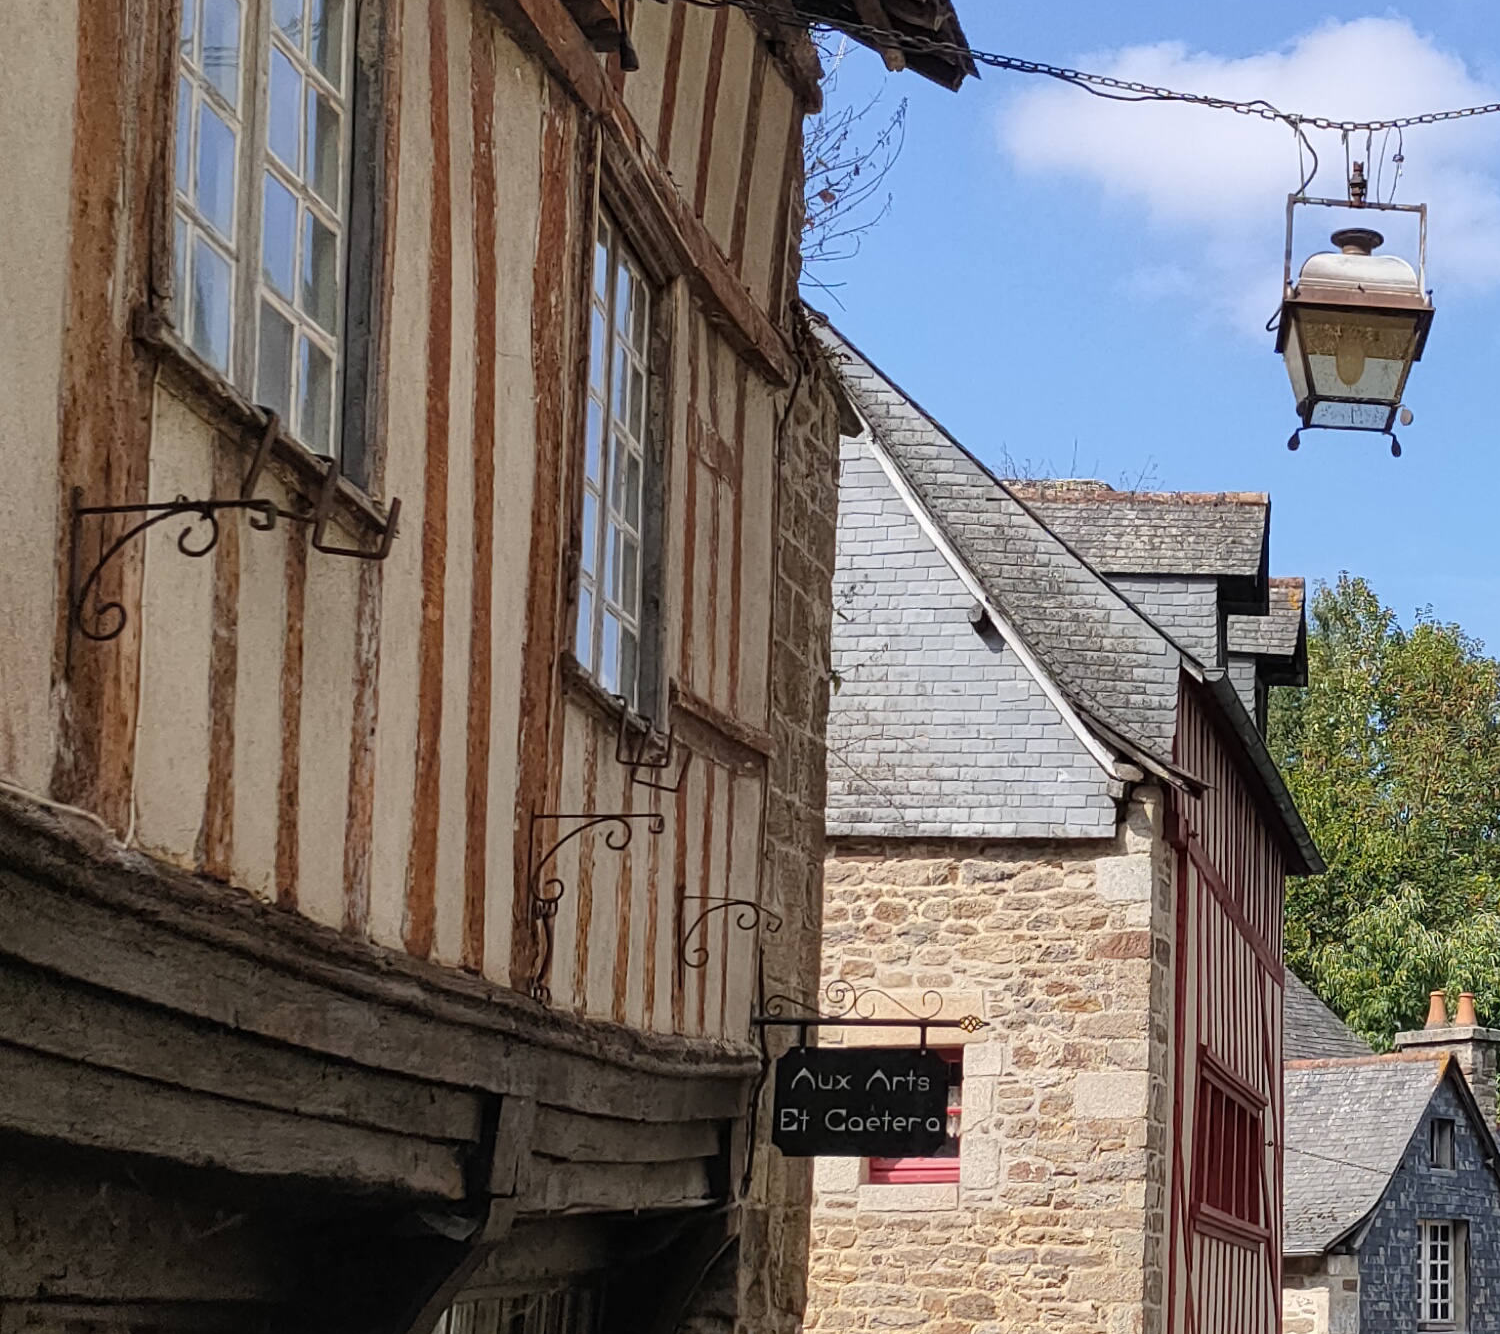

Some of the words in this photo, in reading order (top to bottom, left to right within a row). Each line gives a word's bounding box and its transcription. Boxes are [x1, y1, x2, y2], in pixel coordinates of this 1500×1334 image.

[791, 1067, 851, 1091] Aux
[865, 1068, 931, 1091] Arts
[780, 1108, 810, 1132] Et
[825, 1108, 941, 1132] Caetera
